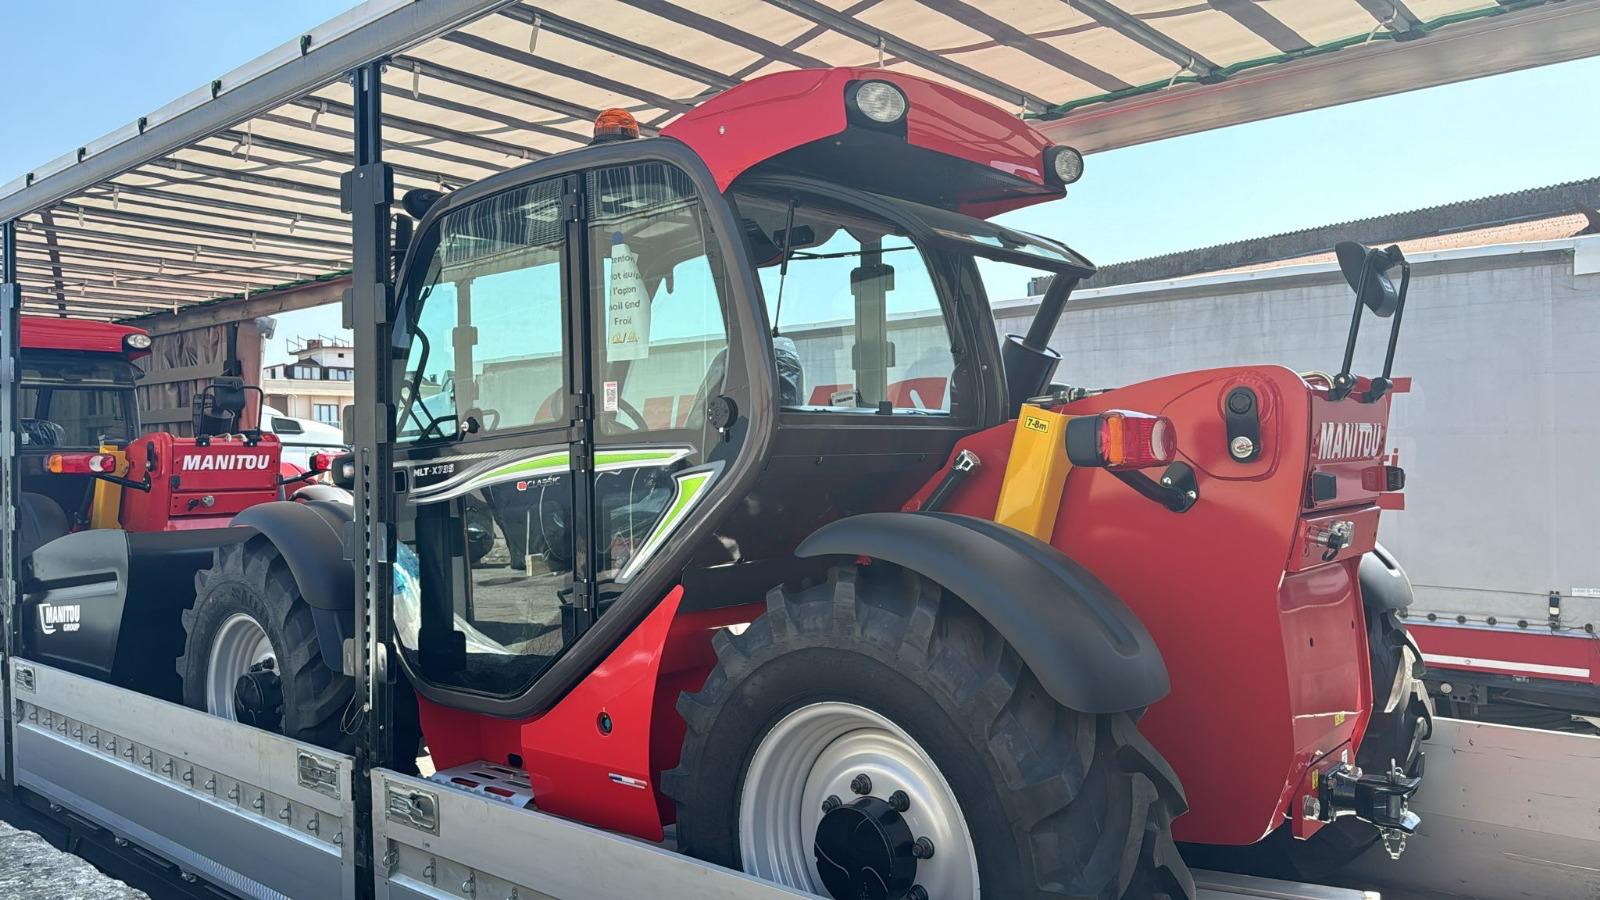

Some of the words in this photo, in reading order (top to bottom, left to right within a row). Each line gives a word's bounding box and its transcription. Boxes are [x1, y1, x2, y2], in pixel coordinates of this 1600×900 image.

[1027, 418, 1047, 431] 7-8m
[1318, 423, 1382, 460] MANITOU
[182, 454, 270, 471] MANITOU
[45, 604, 81, 624] MANITOU
[62, 623, 80, 632] GROUP
